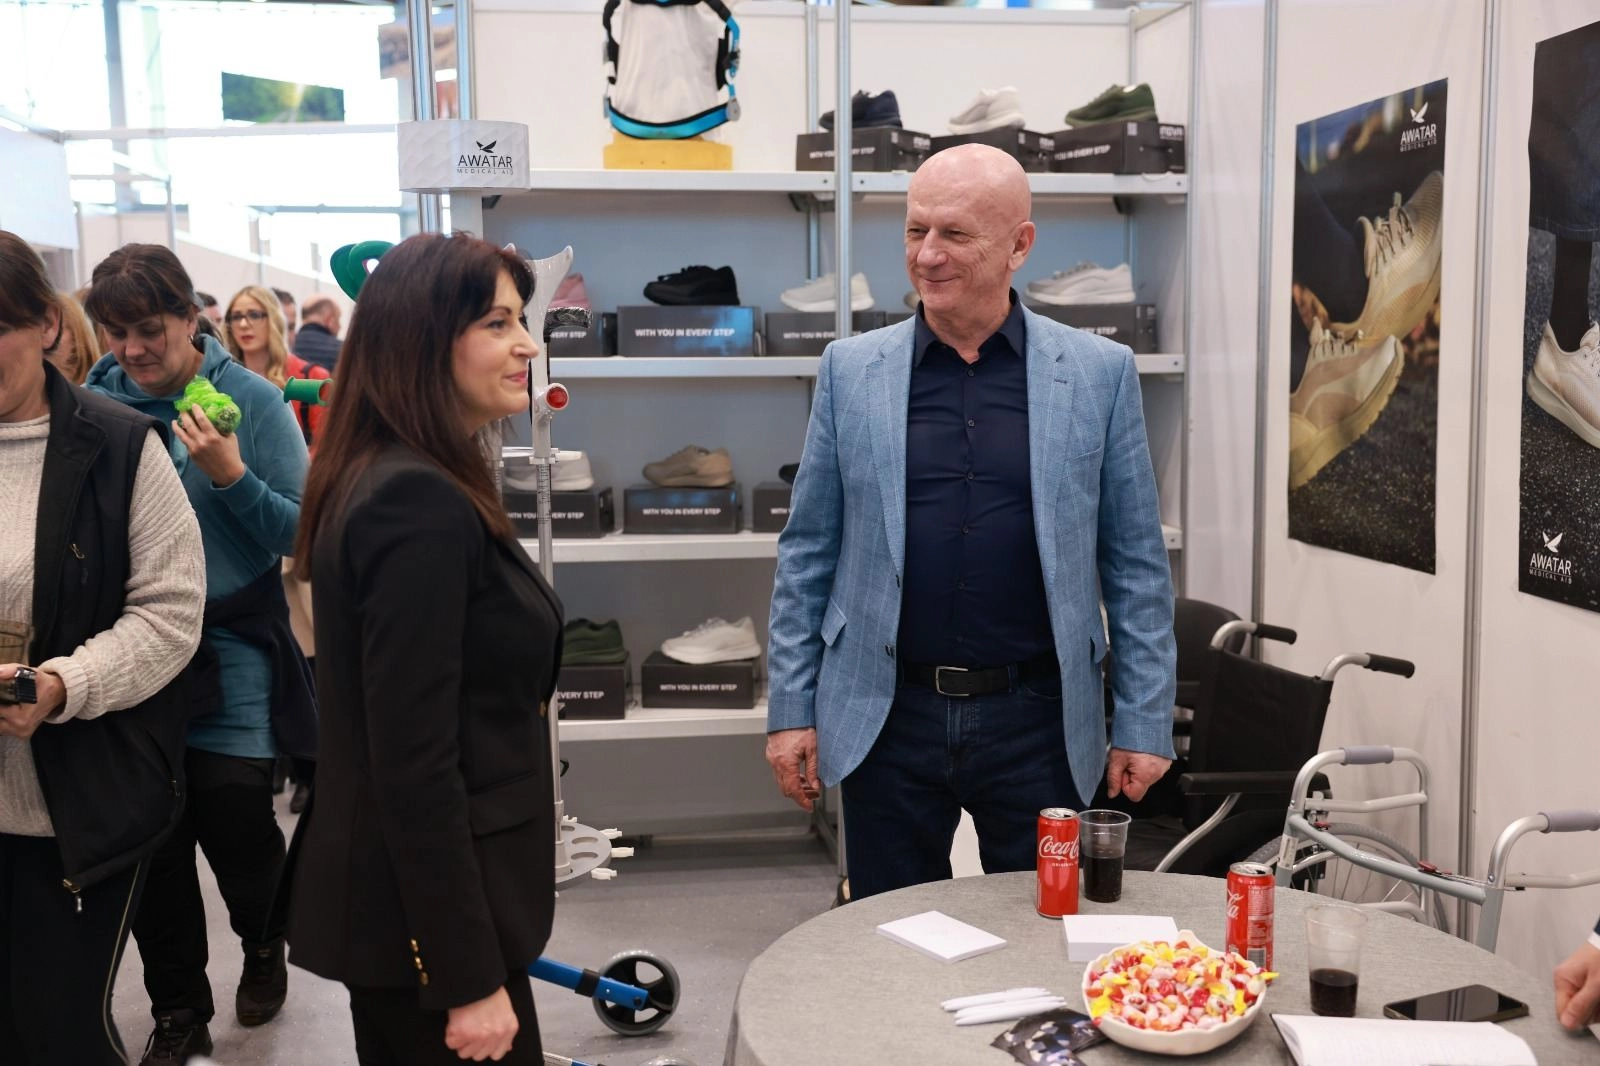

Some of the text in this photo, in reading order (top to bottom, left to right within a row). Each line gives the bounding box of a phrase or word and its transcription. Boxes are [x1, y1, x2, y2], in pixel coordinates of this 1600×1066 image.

[1400, 124, 1437, 145] AWATAR
[458, 154, 513, 168] AWATAR
[549, 331, 587, 339] VERY STEP
[635, 328, 735, 337] WITH YOU IN EVERY STEP
[1530, 552, 1572, 576] AWATAR
[1529, 568, 1558, 581] MEDICAL
[583, 691, 605, 699] STEP
